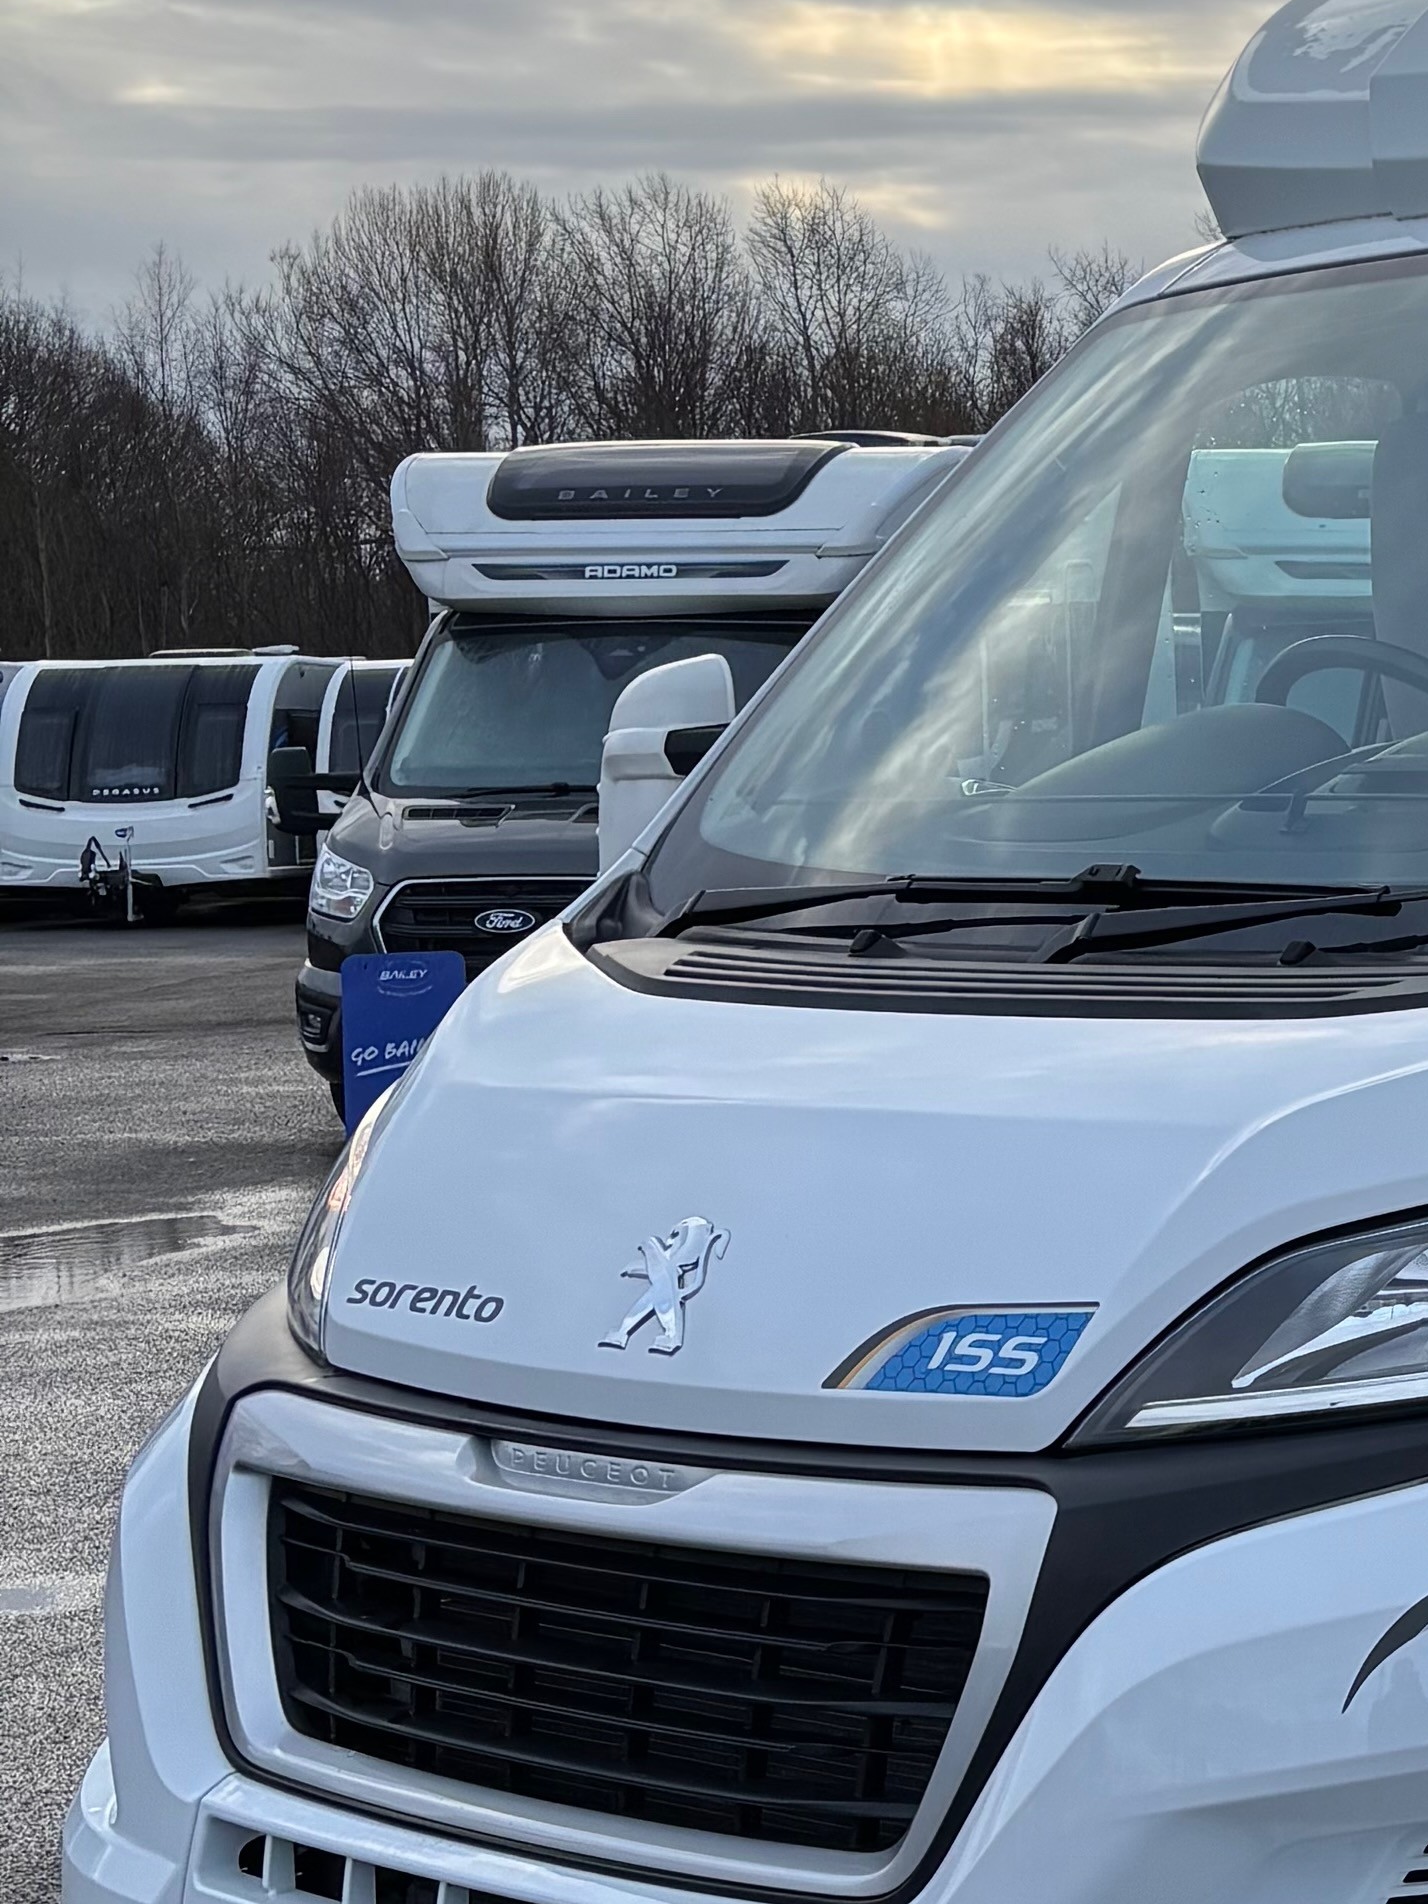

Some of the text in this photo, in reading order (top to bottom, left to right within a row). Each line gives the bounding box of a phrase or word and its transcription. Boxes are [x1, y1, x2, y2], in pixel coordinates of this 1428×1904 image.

[558, 487, 723, 501] BAILEY
[585, 564, 677, 578] ADAMO
[92, 787, 160, 796] PEGASUS
[485, 912, 523, 928] Ford
[351, 1046, 379, 1067] GO
[346, 1278, 505, 1323] sorento
